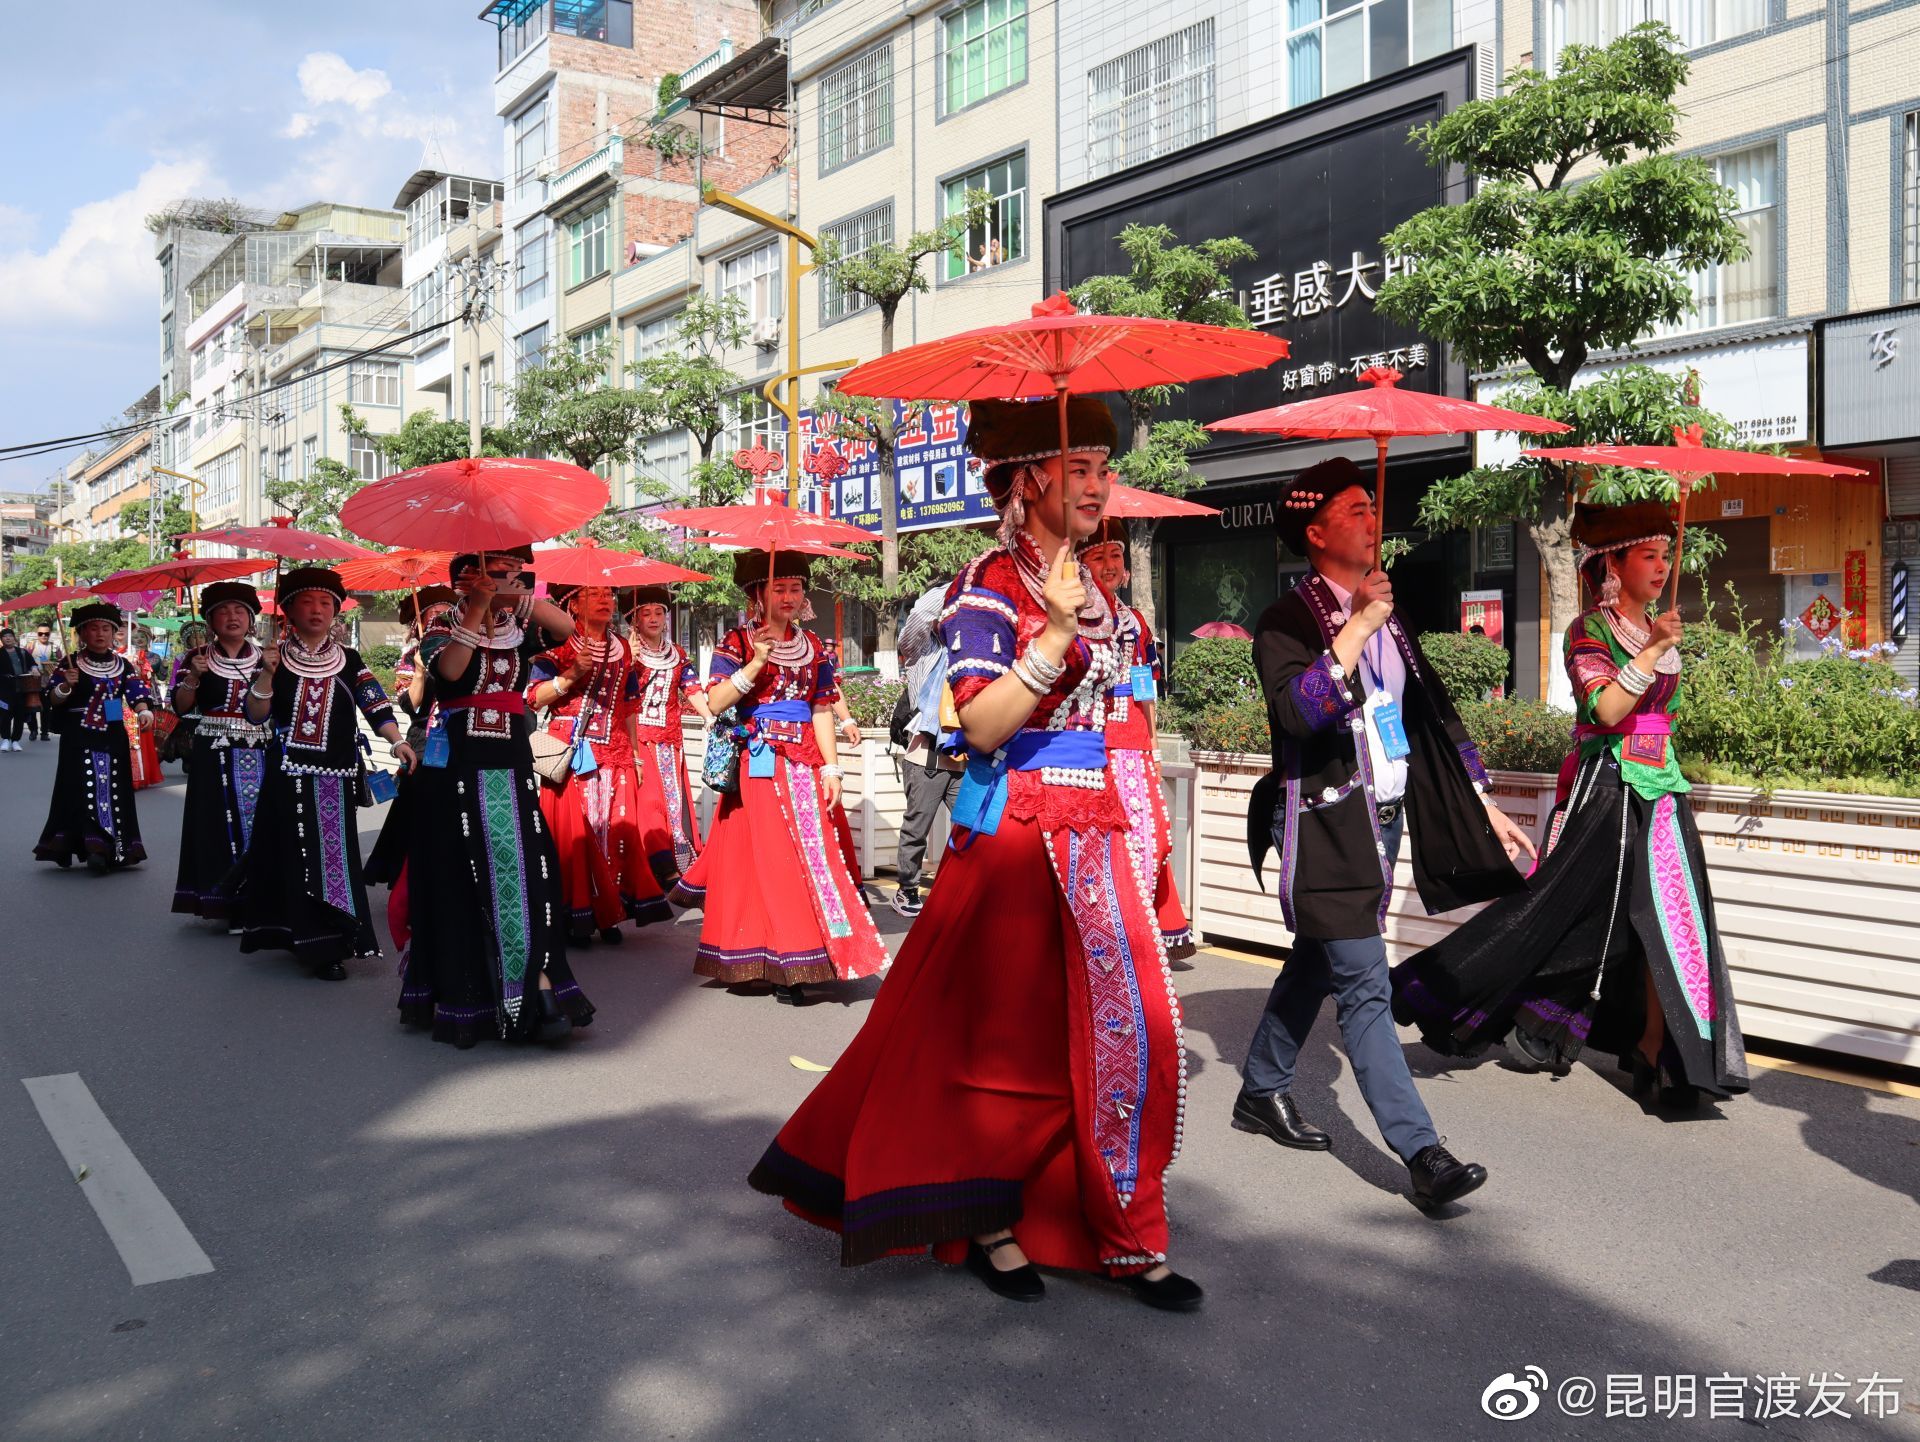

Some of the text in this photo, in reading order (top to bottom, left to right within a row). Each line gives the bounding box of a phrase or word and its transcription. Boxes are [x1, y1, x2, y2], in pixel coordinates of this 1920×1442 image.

[1203, 248, 1418, 327] 垂感大
[1736, 430, 1748, 440] 33
[922, 447, 947, 463] 劳保用品
[1220, 501, 1275, 529] CURTA
